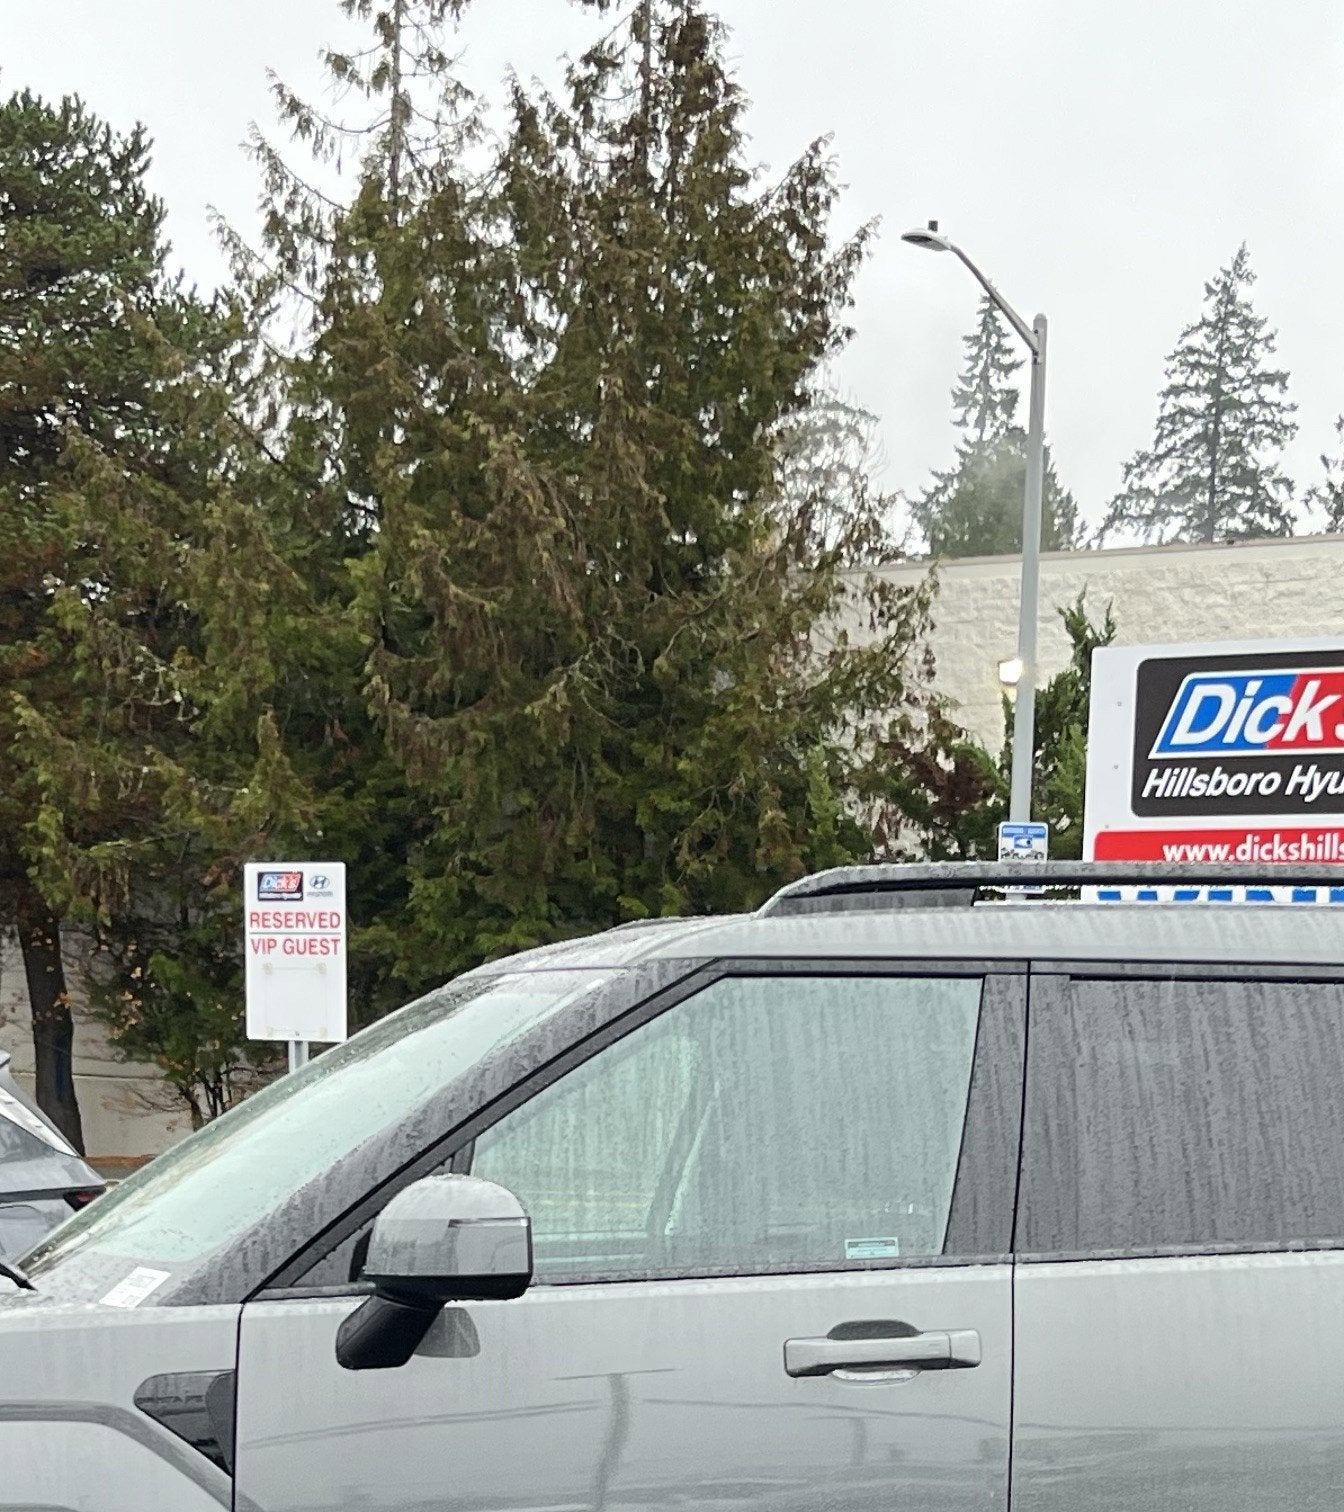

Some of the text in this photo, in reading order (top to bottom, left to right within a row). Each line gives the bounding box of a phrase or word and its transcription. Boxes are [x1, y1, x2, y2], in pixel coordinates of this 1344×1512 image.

[1142, 767, 1282, 798] Hillsboro
[249, 912, 341, 929] RESERVED
[250, 938, 341, 956] VIP GUEST
